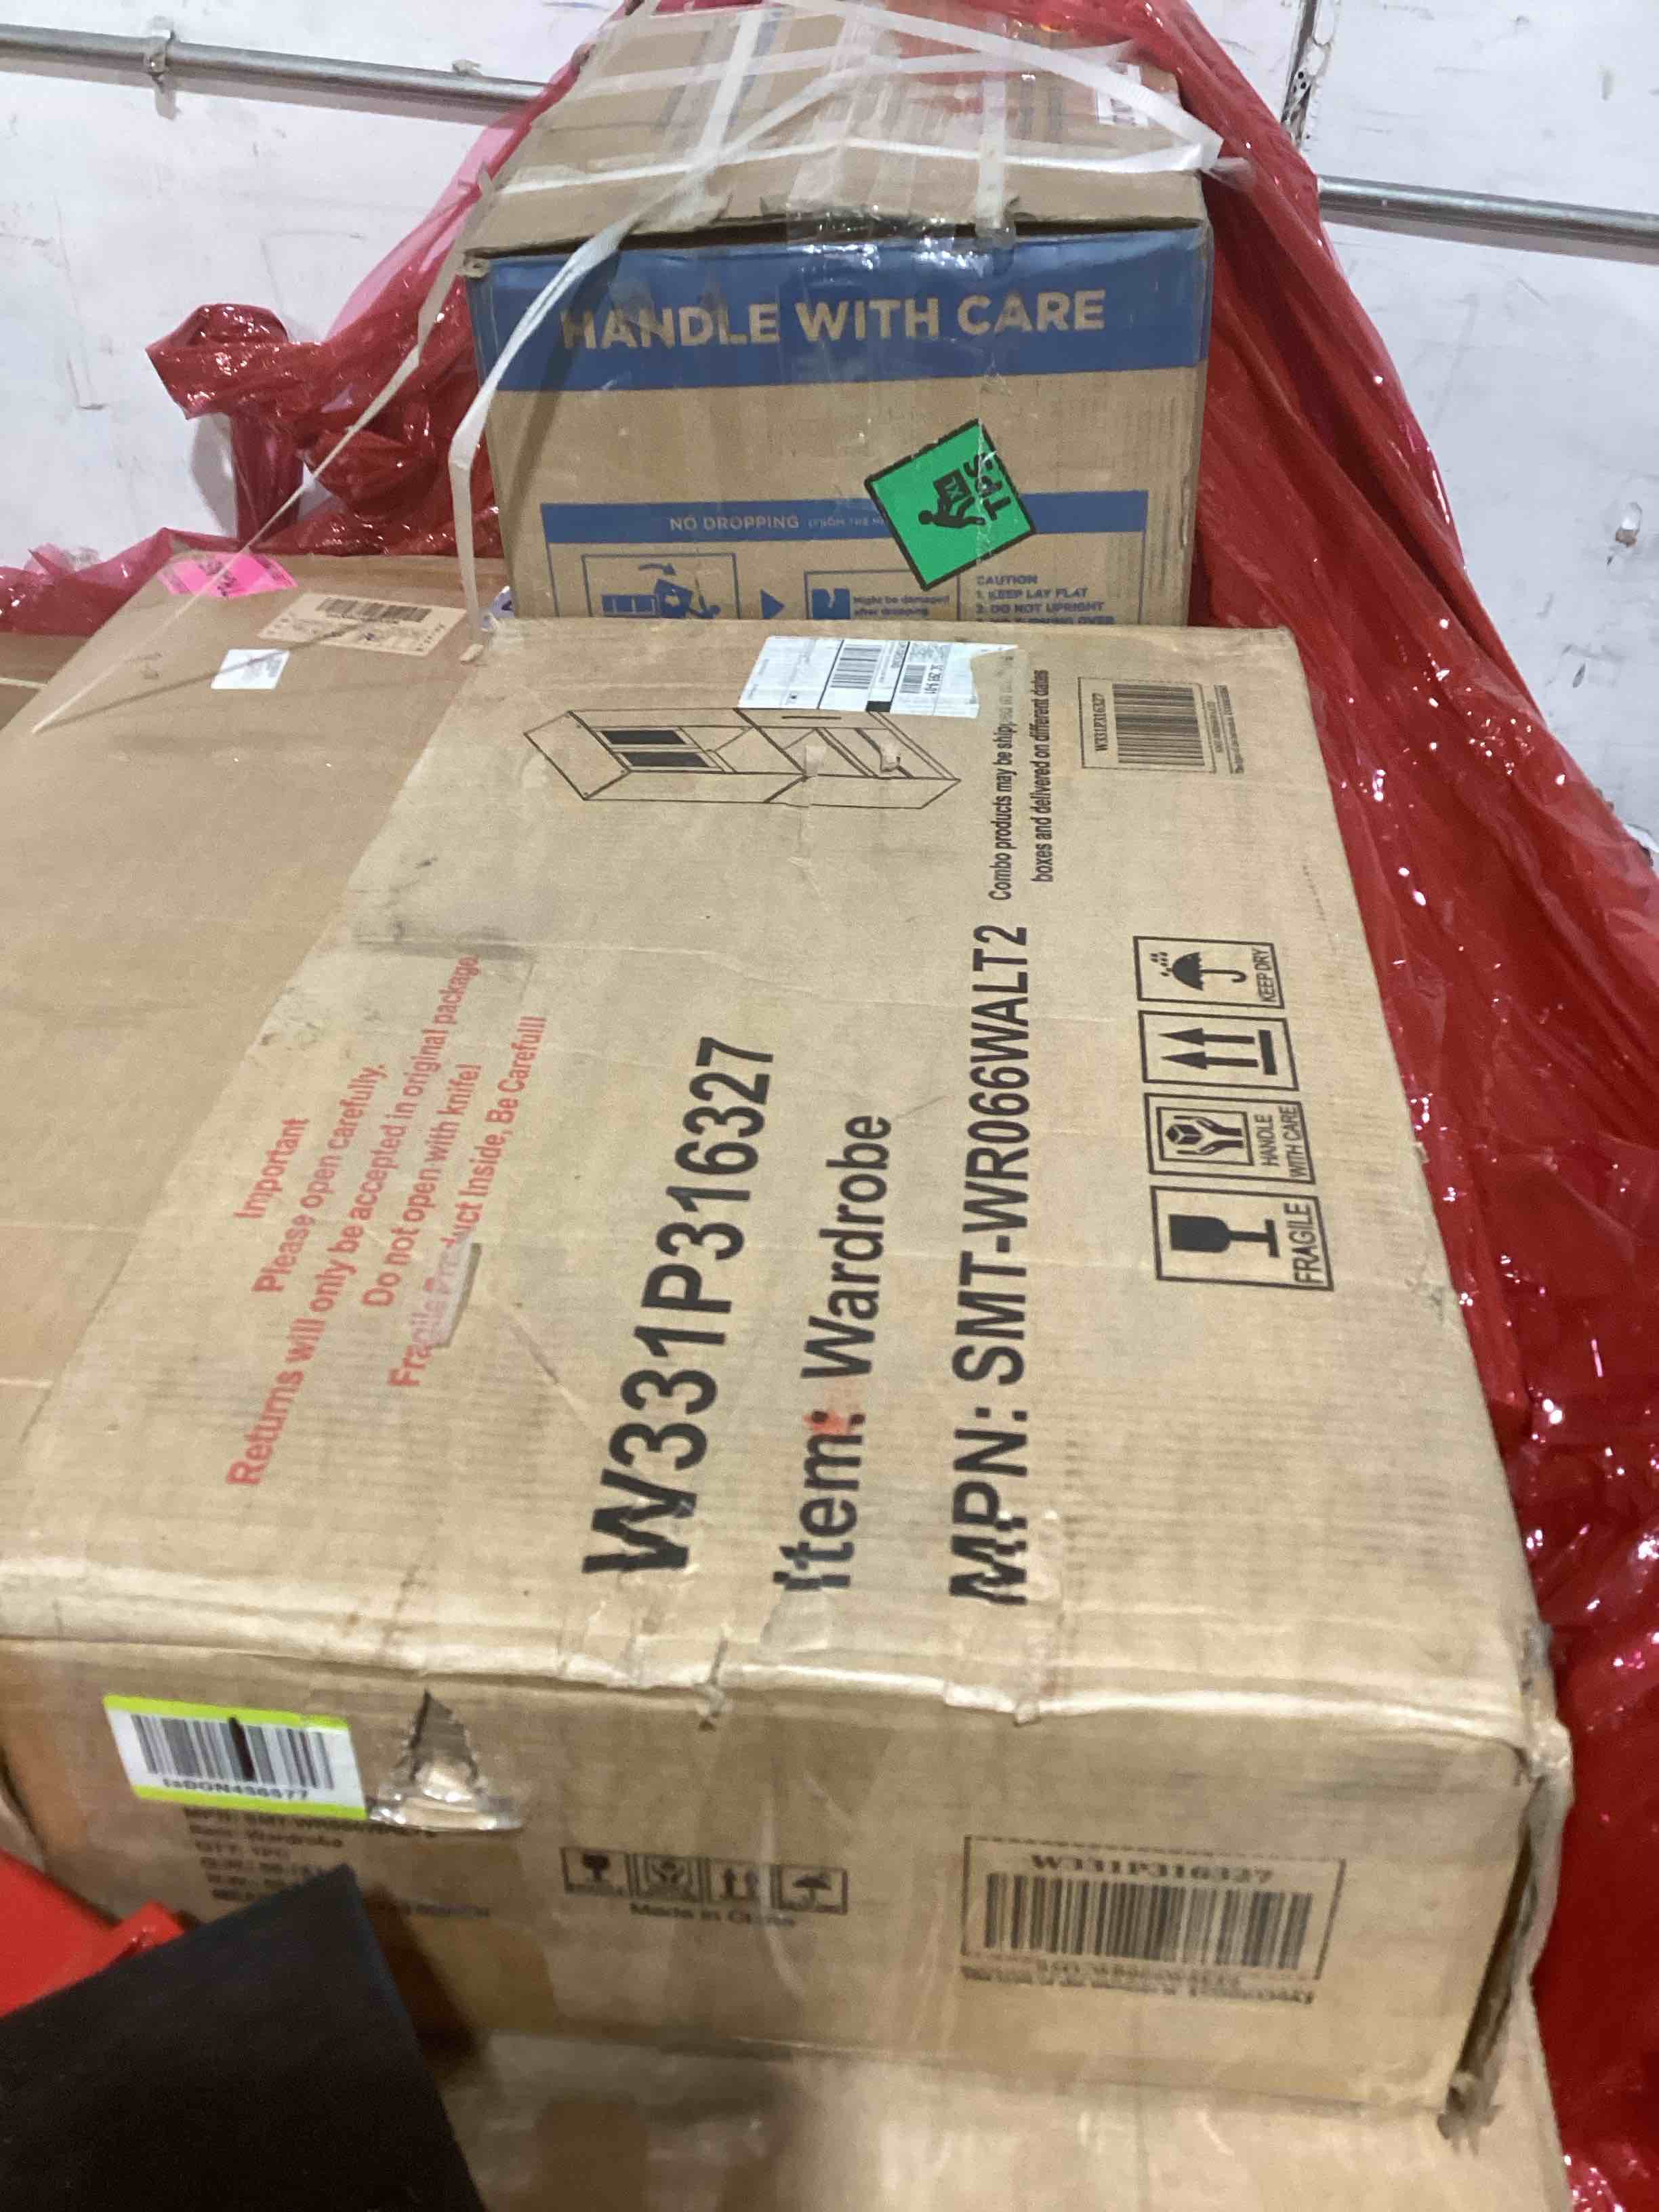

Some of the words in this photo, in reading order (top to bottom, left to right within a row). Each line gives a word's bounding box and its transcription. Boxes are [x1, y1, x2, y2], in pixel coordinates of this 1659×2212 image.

[560, 303, 780, 350] HANDLE
[794, 296, 939, 341] WITH
[956, 289, 1106, 336] CARE
[669, 516, 697, 531] NO
[703, 514, 800, 531] DROPPING
[977, 575, 1038, 586] CAUTION
[987, 588, 1023, 599] KEEP
[1026, 588, 1051, 598] LAY
[1055, 587, 1089, 598] FLAT
[1014, 602, 1043, 613] NOT
[1046, 601, 1105, 613] UPRIGHT
[1029, 670, 1049, 696] dates
[1029, 699, 1050, 741] different
[992, 750, 1013, 766] be
[1033, 744, 1050, 758] on
[997, 765, 1017, 794] may
[1029, 760, 1052, 815] delivered
[990, 795, 1017, 850] products
[1030, 817, 1052, 841] and
[988, 852, 1012, 901] Combo
[1031, 843, 1054, 882] boxes
[1252, 947, 1274, 977] DRY
[1257, 977, 1277, 1004] KEEP
[403, 1028, 449, 1098] original
[384, 1102, 417, 1120] in
[485, 1097, 520, 1124] Be
[1279, 1105, 1304, 1146] CARE
[952, 922, 1030, 1386] SMT-WR066WALT2
[1254, 1113, 1281, 1167] HANDLE
[1284, 1147, 1308, 1179] WITH
[233, 1117, 310, 1219] Important
[349, 1124, 407, 1221] accepted
[457, 1132, 514, 1197] Inside,
[251, 1214, 315, 1293] Please
[300, 1154, 342, 1209] open
[361, 1271, 402, 1307] Do
[384, 1227, 420, 1266] not
[402, 1167, 442, 1223] open
[424, 1121, 461, 1163] with
[327, 1224, 365, 1254] be
[800, 1114, 893, 1380] Wardrobe
[1284, 1201, 1325, 1286] FRAGILE
[309, 1258, 357, 1313] only
[581, 1036, 775, 1576] W331P316327
[285, 1317, 327, 1364] will
[226, 1370, 305, 1486] Returns
[773, 1410, 867, 1593] Item:
[949, 1406, 1030, 1606] MPN:
